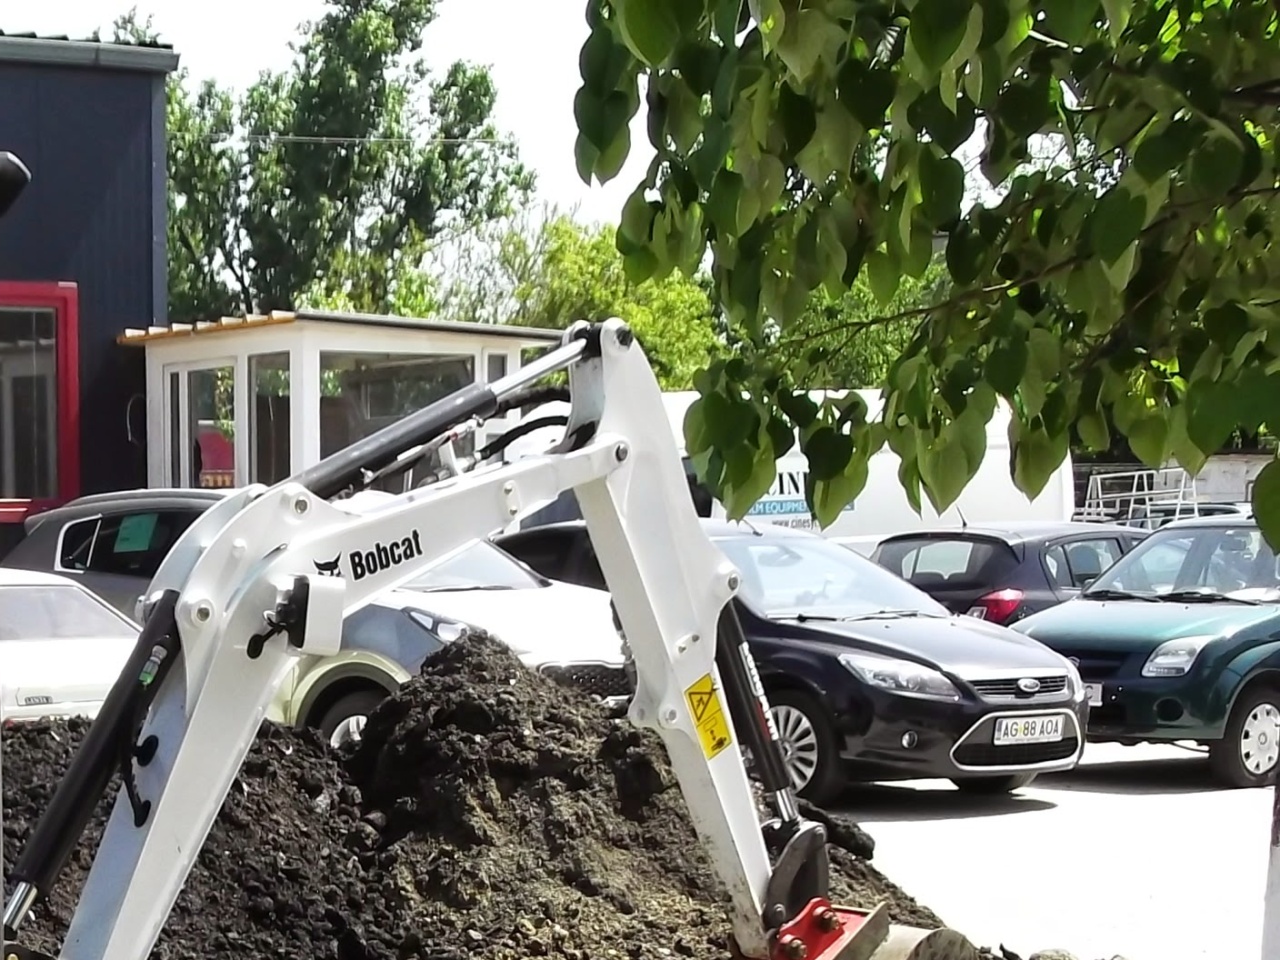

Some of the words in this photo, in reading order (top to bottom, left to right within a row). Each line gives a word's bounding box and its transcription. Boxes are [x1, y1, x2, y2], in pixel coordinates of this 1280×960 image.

[765, 500, 808, 514] EQUIPME
[349, 529, 423, 581] Bobcat
[1003, 721, 1019, 738] AG
[1022, 720, 1037, 737] 88
